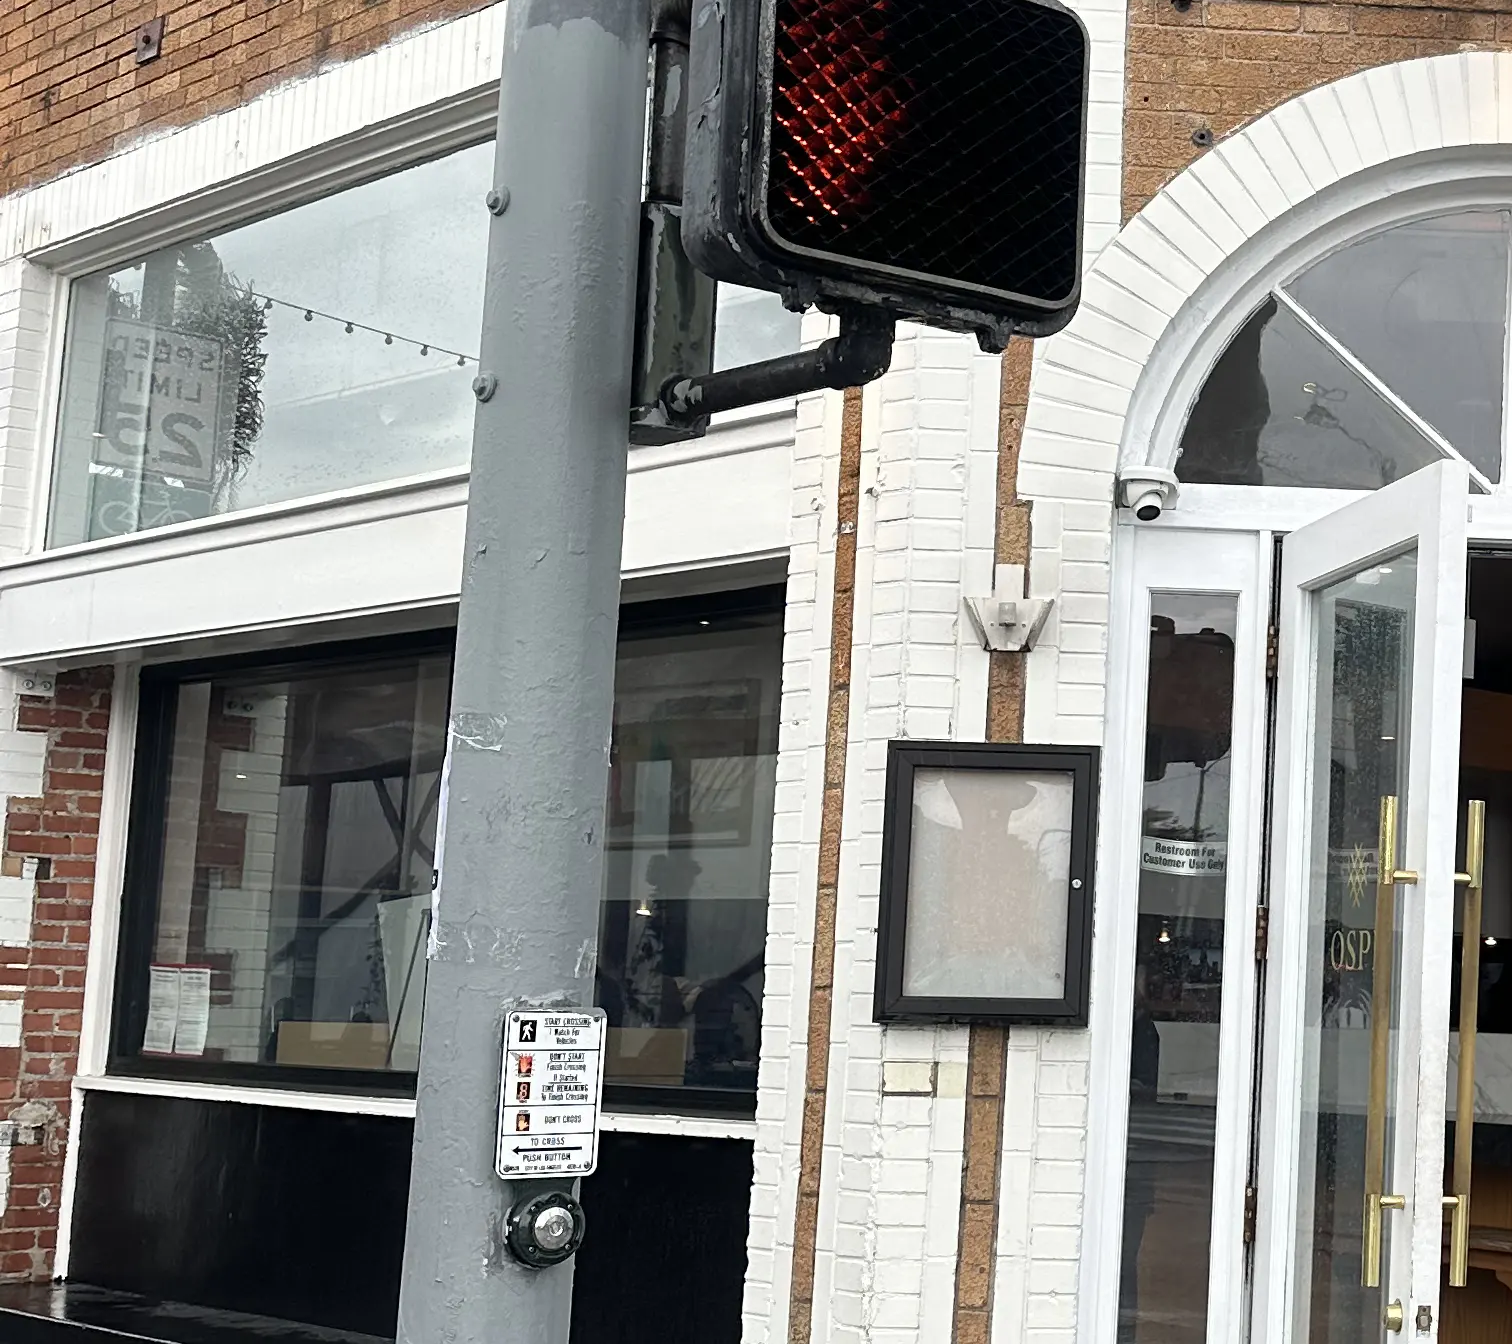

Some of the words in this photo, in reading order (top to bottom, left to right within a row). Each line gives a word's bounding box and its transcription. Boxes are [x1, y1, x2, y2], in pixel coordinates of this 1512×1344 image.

[1155, 842, 1200, 857] Restroom
[1202, 847, 1216, 857] For
[1144, 853, 1186, 868] Customer
[1189, 859, 1206, 869] Use
[1208, 859, 1224, 871] Only
[1331, 930, 1377, 971] OSP
[544, 1017, 561, 1026] START
[562, 1017, 592, 1027] CROSSING
[549, 1052, 567, 1061] DON'T
[568, 1052, 585, 1062] START
[546, 1063, 563, 1071] Finish
[563, 1063, 587, 1073] Crossing
[556, 1084, 589, 1093] REMAINING
[548, 1093, 564, 1101] Finish
[565, 1093, 589, 1102] Crossing
[544, 1115, 562, 1125] DON'T
[562, 1114, 582, 1124] CROSS
[530, 1137, 539, 1146] TO
[541, 1136, 565, 1146] CROSS
[522, 1154, 542, 1163] PUSH
[544, 1152, 571, 1162] BUTTON
